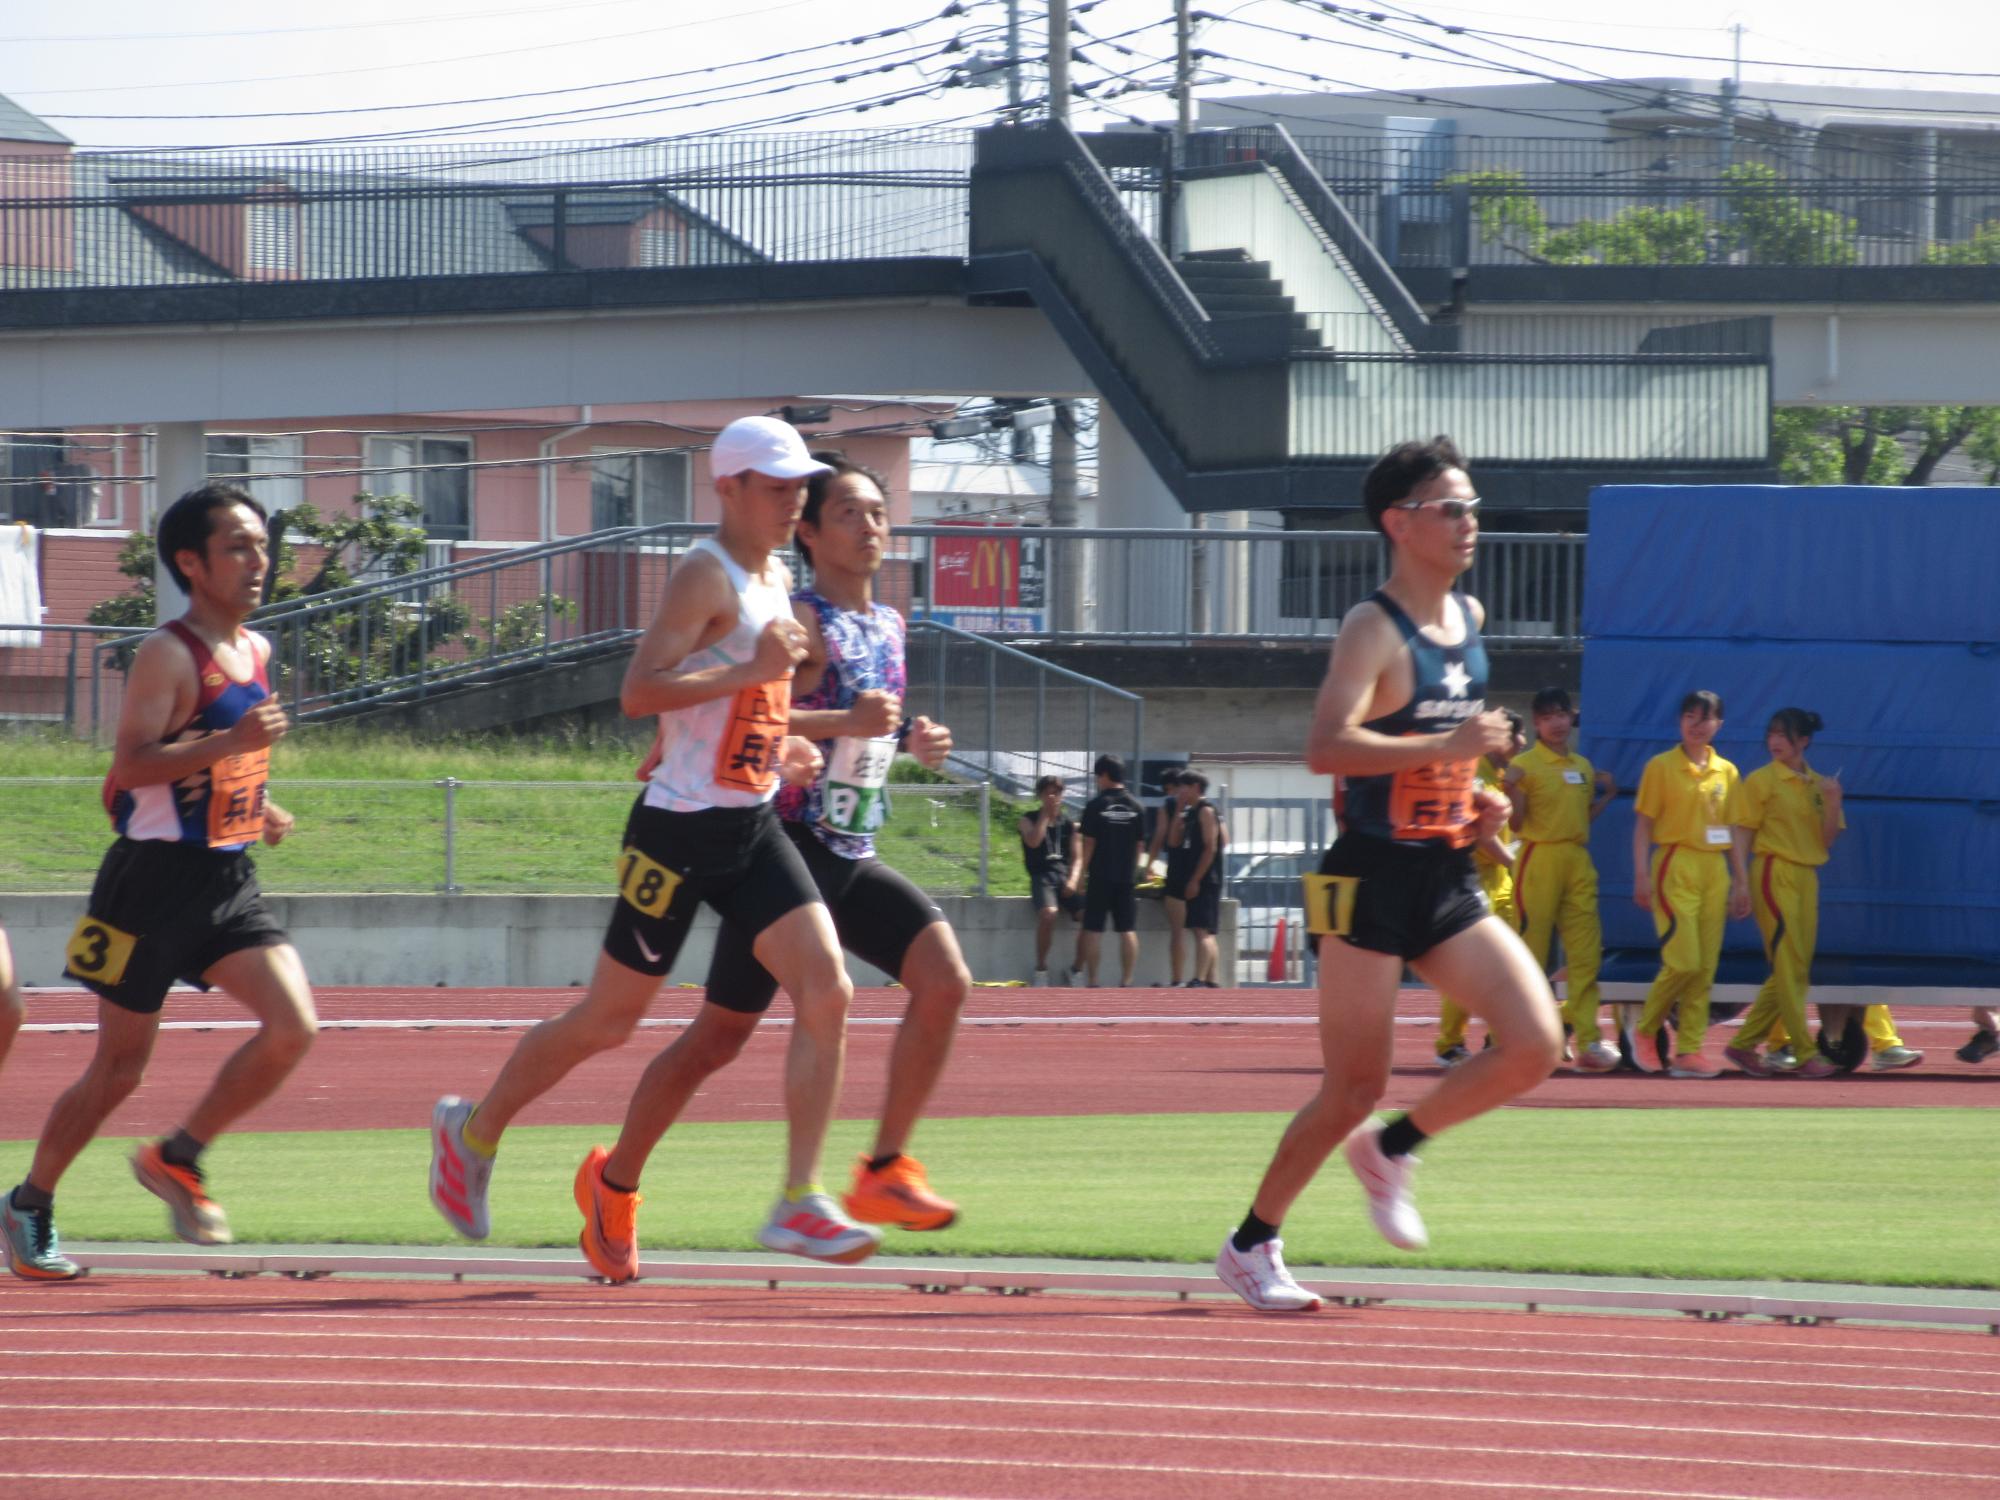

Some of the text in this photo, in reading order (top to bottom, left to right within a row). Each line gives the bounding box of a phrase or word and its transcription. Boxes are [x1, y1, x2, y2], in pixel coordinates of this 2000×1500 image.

[622, 854, 666, 907] 18
[1322, 882, 1339, 931] 1
[72, 925, 110, 973] 3
